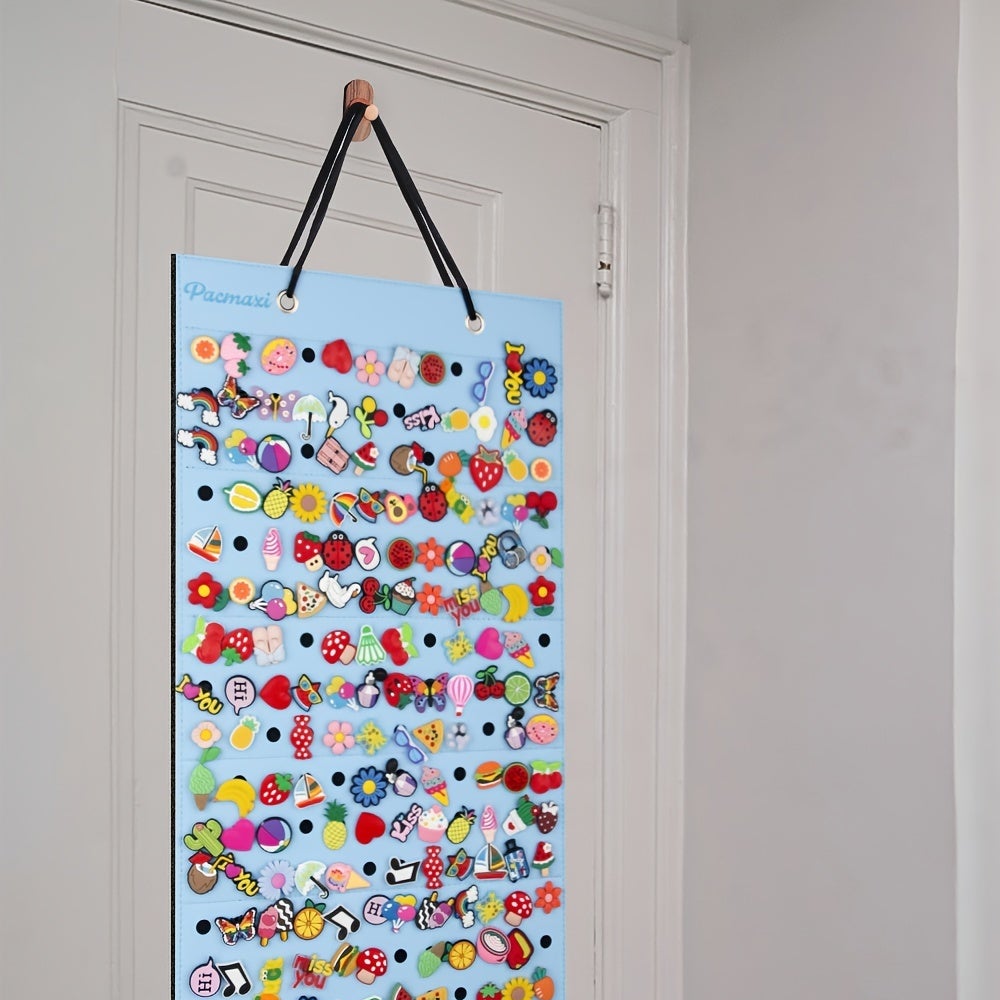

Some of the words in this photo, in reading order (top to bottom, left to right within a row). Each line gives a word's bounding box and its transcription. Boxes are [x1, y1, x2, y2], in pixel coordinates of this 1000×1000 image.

[184, 281, 271, 308] Pacmaxi
[505, 342, 524, 355] I
[234, 681, 247, 701] Hi
[367, 901, 384, 917] H
[198, 973, 212, 992] Hi
